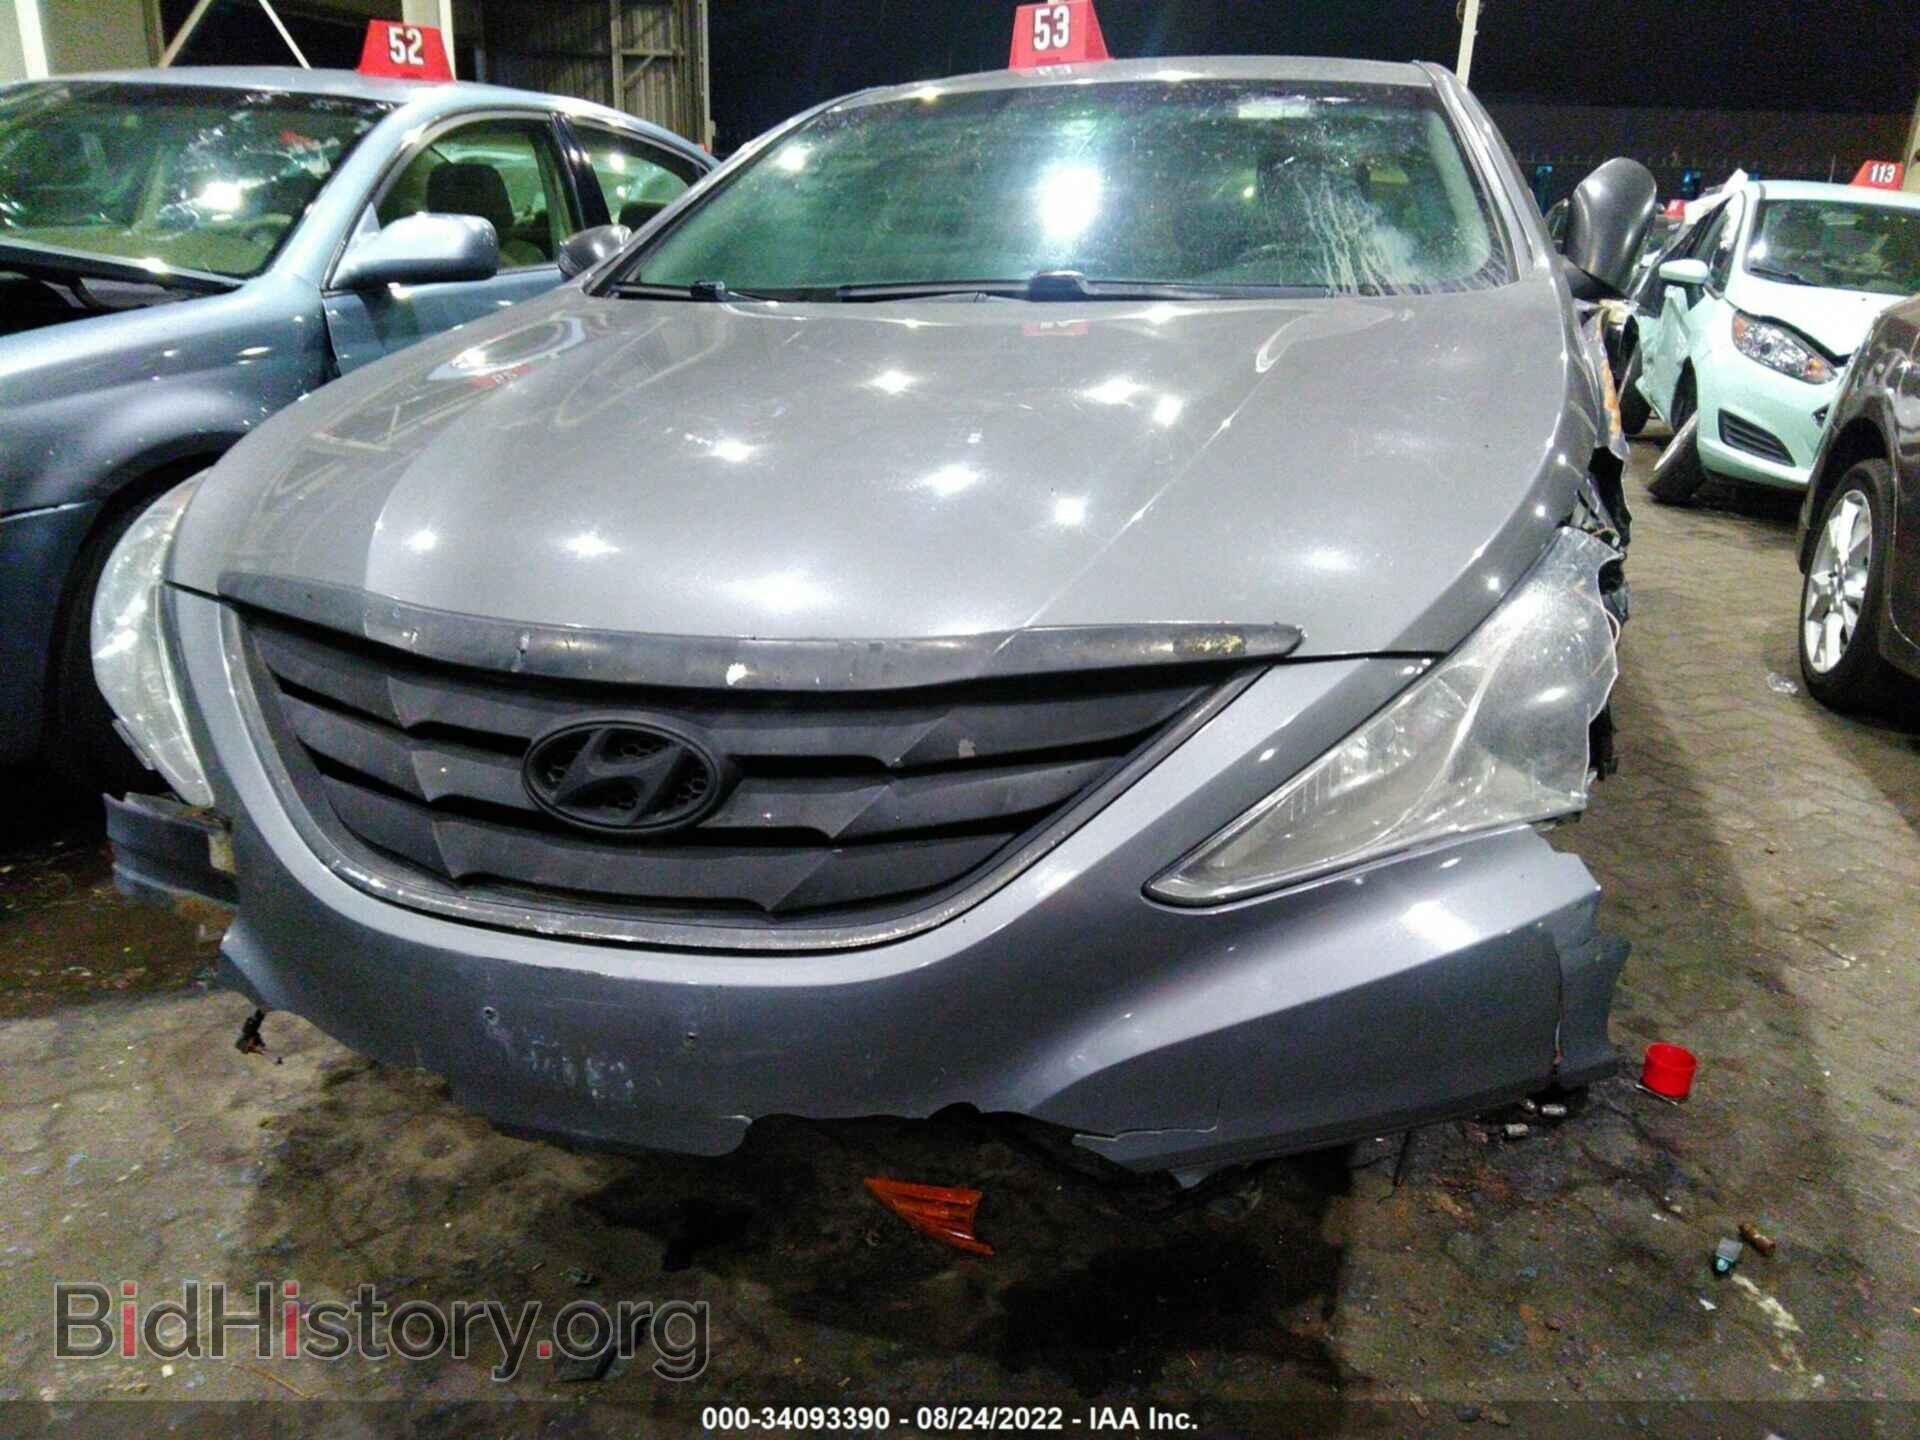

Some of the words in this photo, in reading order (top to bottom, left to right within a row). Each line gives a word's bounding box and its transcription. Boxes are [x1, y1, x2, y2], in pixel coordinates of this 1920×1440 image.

[388, 26, 424, 65] 52
[1033, 5, 1070, 51] 53
[1871, 163, 1896, 183] 113
